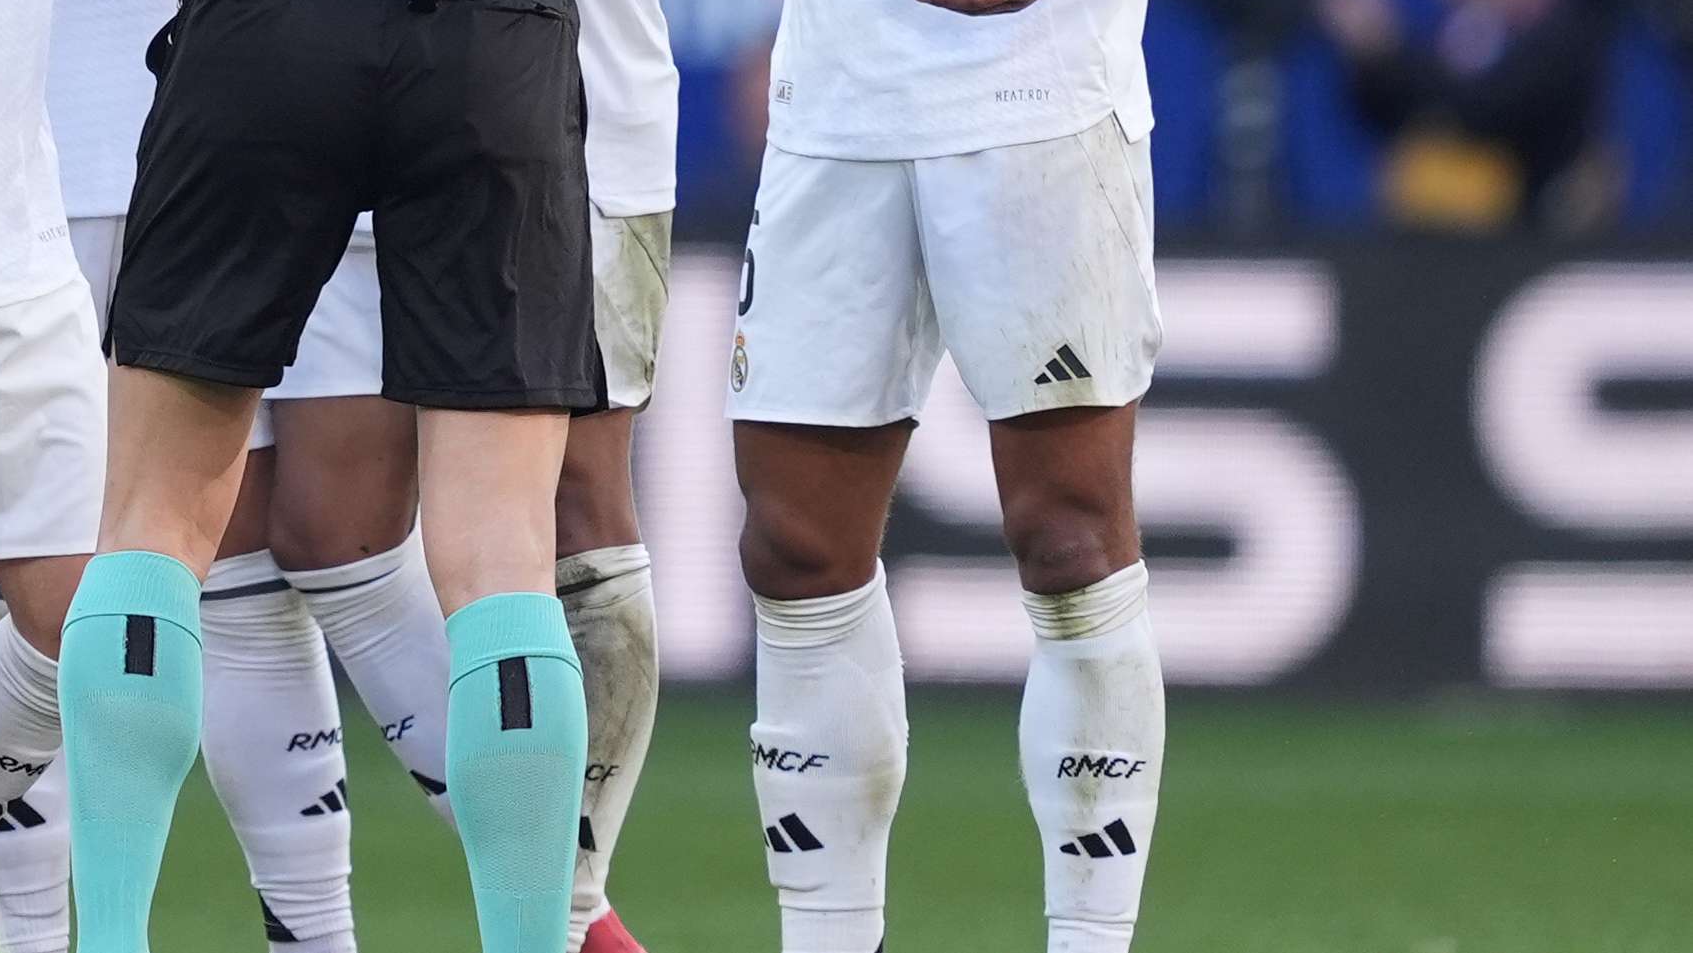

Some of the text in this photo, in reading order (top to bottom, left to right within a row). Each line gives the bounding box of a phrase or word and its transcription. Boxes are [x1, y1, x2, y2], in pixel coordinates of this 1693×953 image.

[380, 715, 415, 742] CF
[585, 764, 620, 782] CF
[1057, 756, 1147, 779] RMCF
